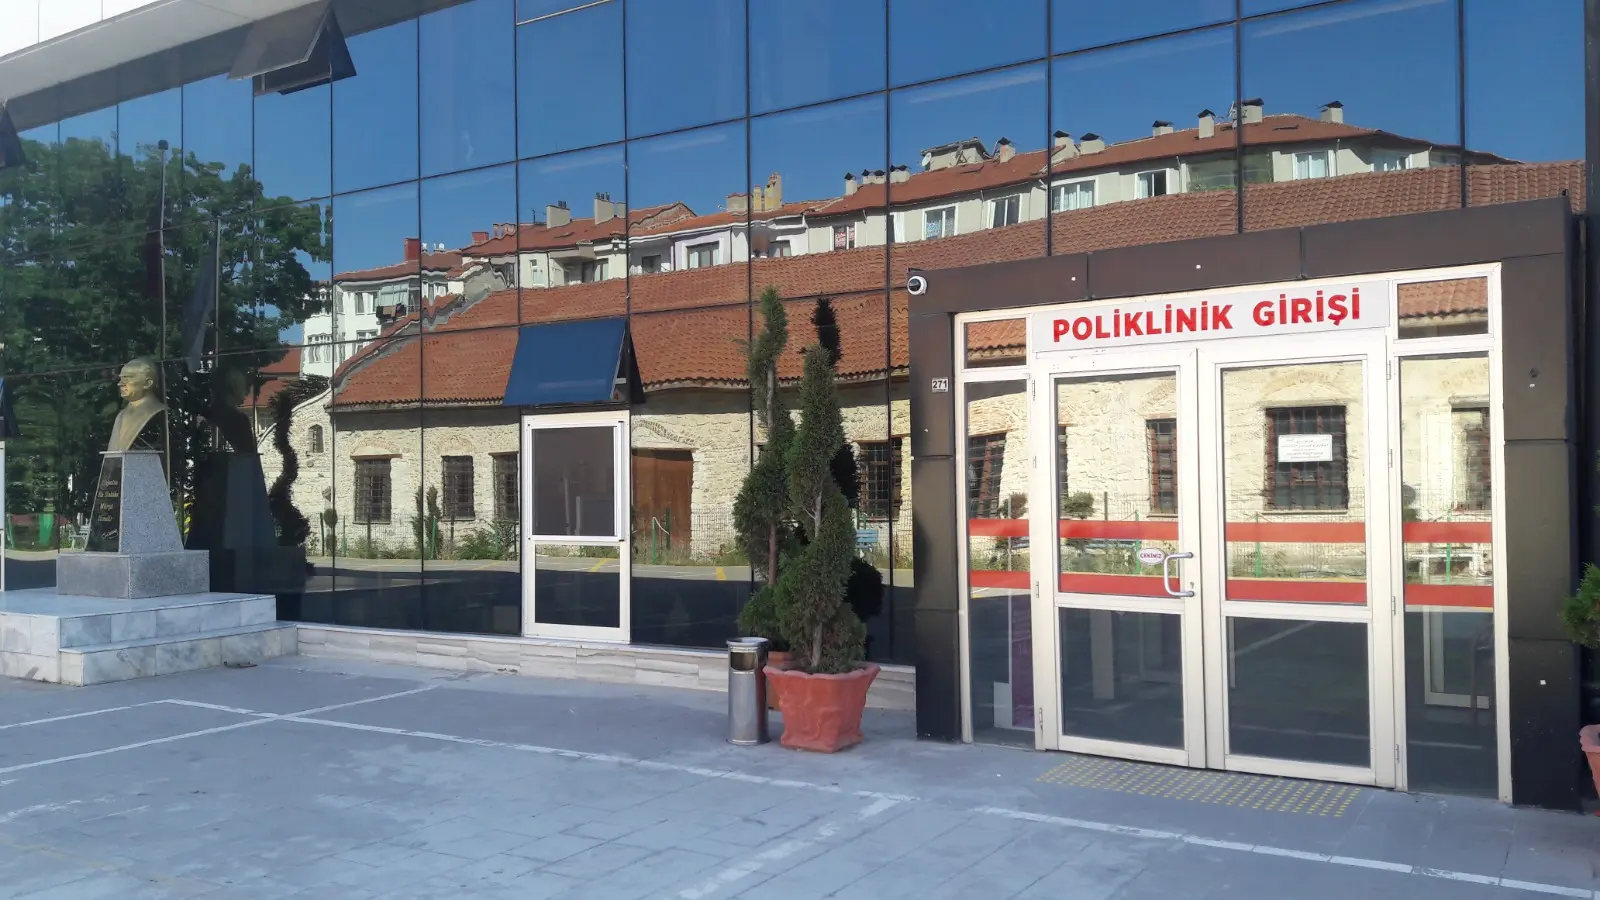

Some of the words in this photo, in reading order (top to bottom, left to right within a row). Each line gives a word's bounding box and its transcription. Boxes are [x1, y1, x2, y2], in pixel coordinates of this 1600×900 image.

[1053, 301, 1232, 343] POLİKLİNİK
[1253, 288, 1360, 326] GİRİŞİ
[932, 380, 947, 388] 271
